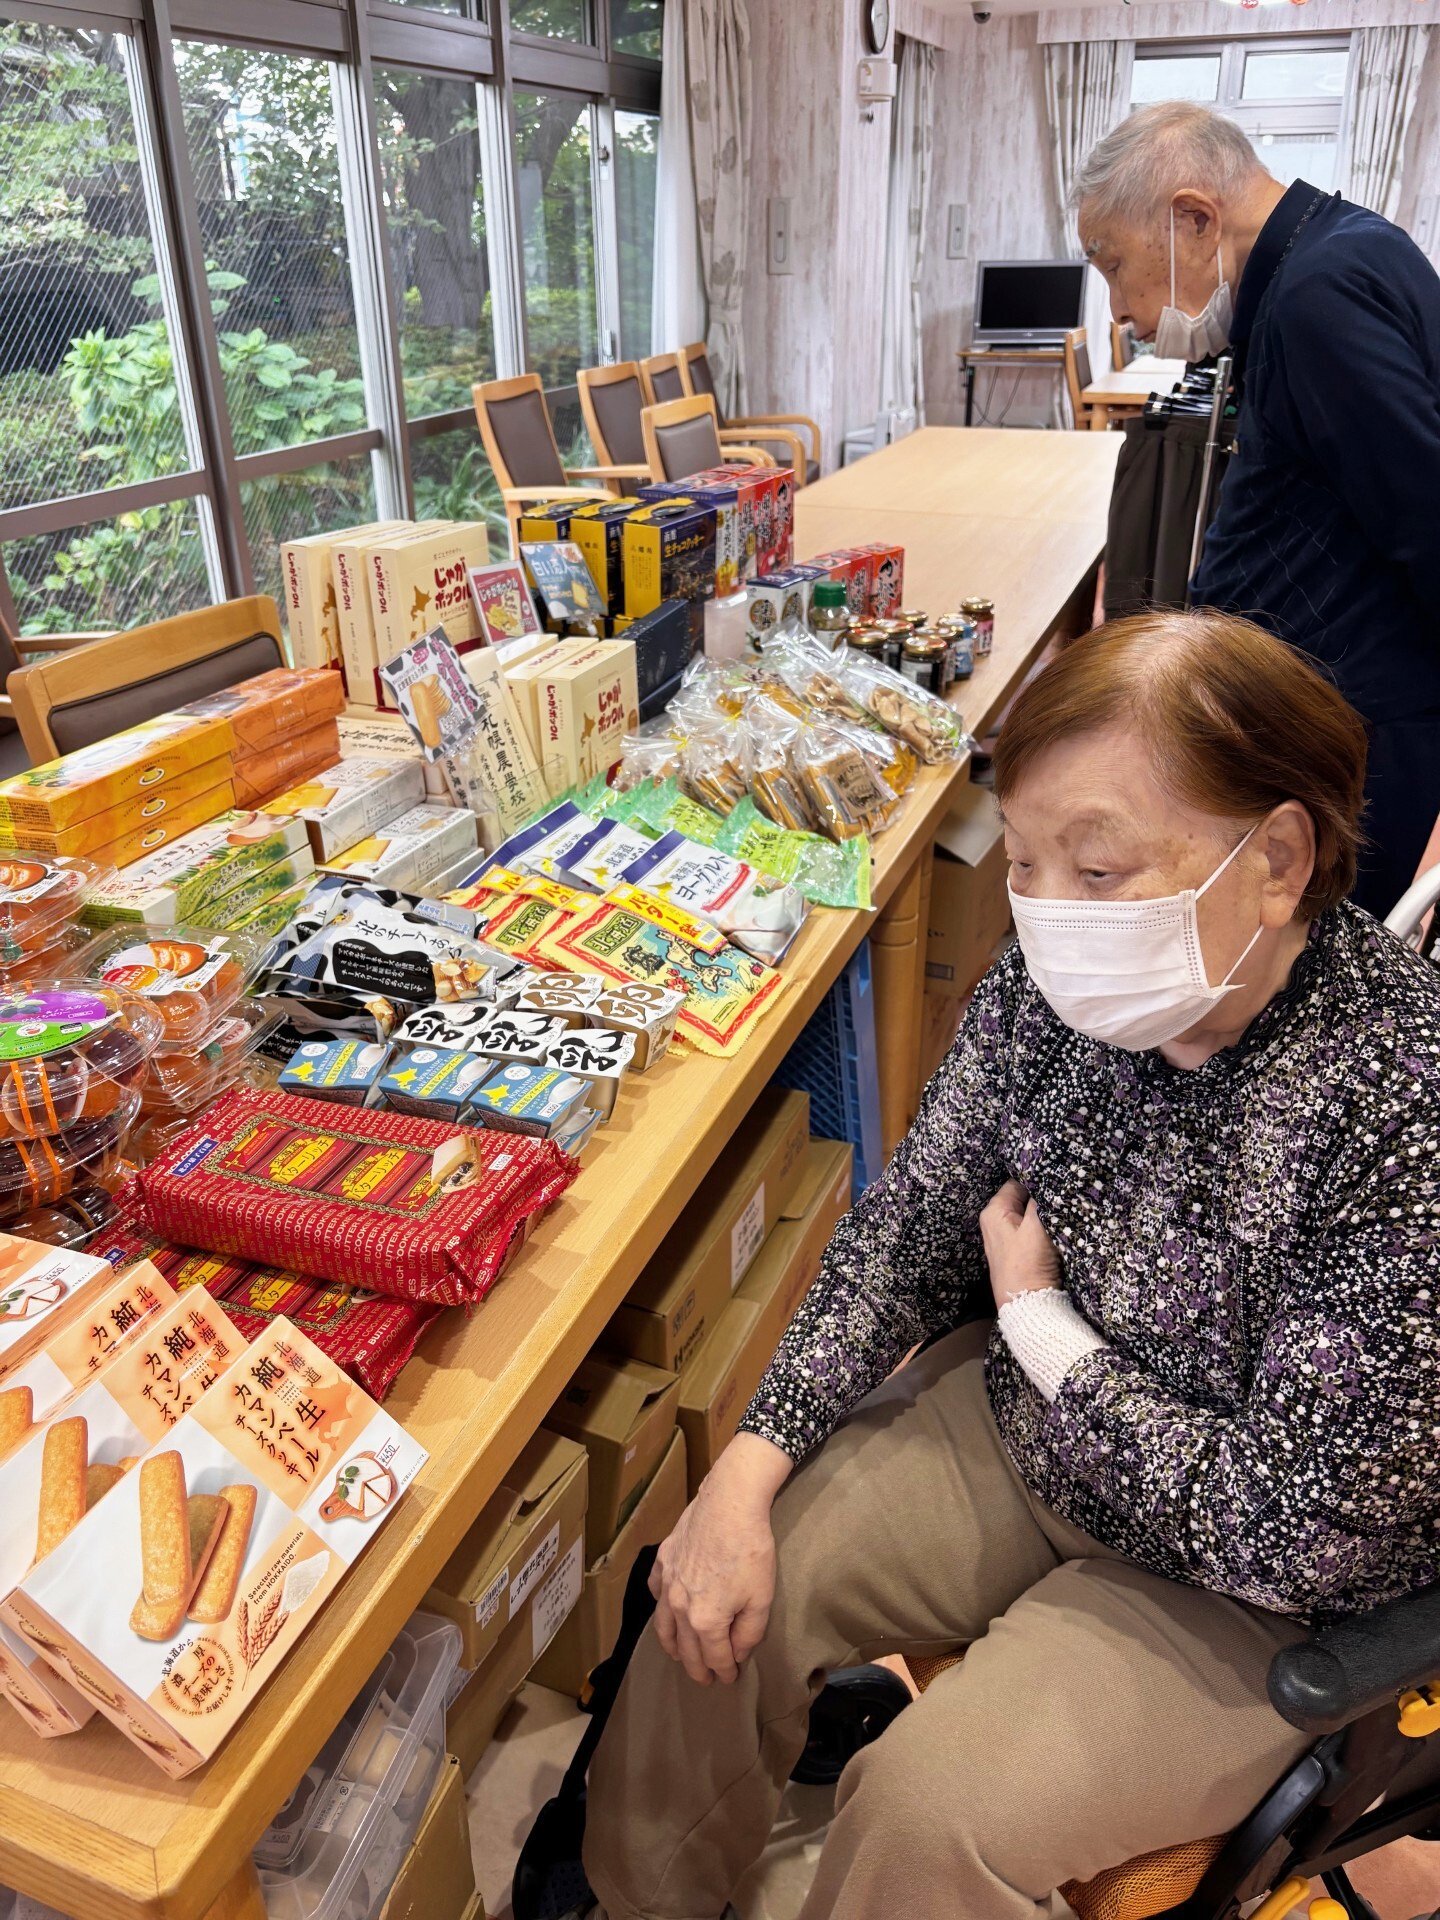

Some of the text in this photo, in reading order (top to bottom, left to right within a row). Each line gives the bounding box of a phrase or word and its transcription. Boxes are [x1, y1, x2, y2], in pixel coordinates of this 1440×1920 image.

[434, 556, 467, 589] じゃが
[676, 855, 730, 901] ヨーグルト
[588, 914, 638, 952] 北海道
[279, 1138, 330, 1181] バターリッチ
[352, 1151, 401, 1198] バターリッチ
[433, 1194, 461, 1222] COOKIES
[440, 1187, 478, 1228] BUTTER RICH
[454, 1196, 481, 1226] COOKIES
[460, 1165, 519, 1232] BUTTER RICH COOKIES
[303, 1213, 318, 1249] BUTTER
[313, 1208, 337, 1244] COOKIES
[324, 1217, 338, 1253] BUTTER
[333, 1213, 358, 1249] COOKIES
[344, 1222, 359, 1259] BUTTER
[354, 1218, 378, 1254] COOKIES
[364, 1226, 381, 1264] BUTTER
[375, 1222, 398, 1259] COOKIES
[396, 1226, 418, 1262] COOKIES
[384, 1231, 400, 1269] BUTTER
[163, 1326, 196, 1362] 純
[188, 1311, 230, 1362] 北海道
[367, 1316, 393, 1346] BUTTER
[272, 1340, 323, 1388] 北海道
[250, 1355, 326, 1430] 純 生
[234, 1382, 320, 1474] カマンベール
[234, 1413, 309, 1483] チーズクッキー
[377, 1443, 398, 1466] ¥450
[247, 1530, 305, 1600] Selected raw materials
[252, 1553, 298, 1606] from HOKKAIDO.
[161, 1637, 195, 1678] 北海道から
[182, 1655, 216, 1697] チーズの
[190, 1664, 227, 1708] 美味しさ
